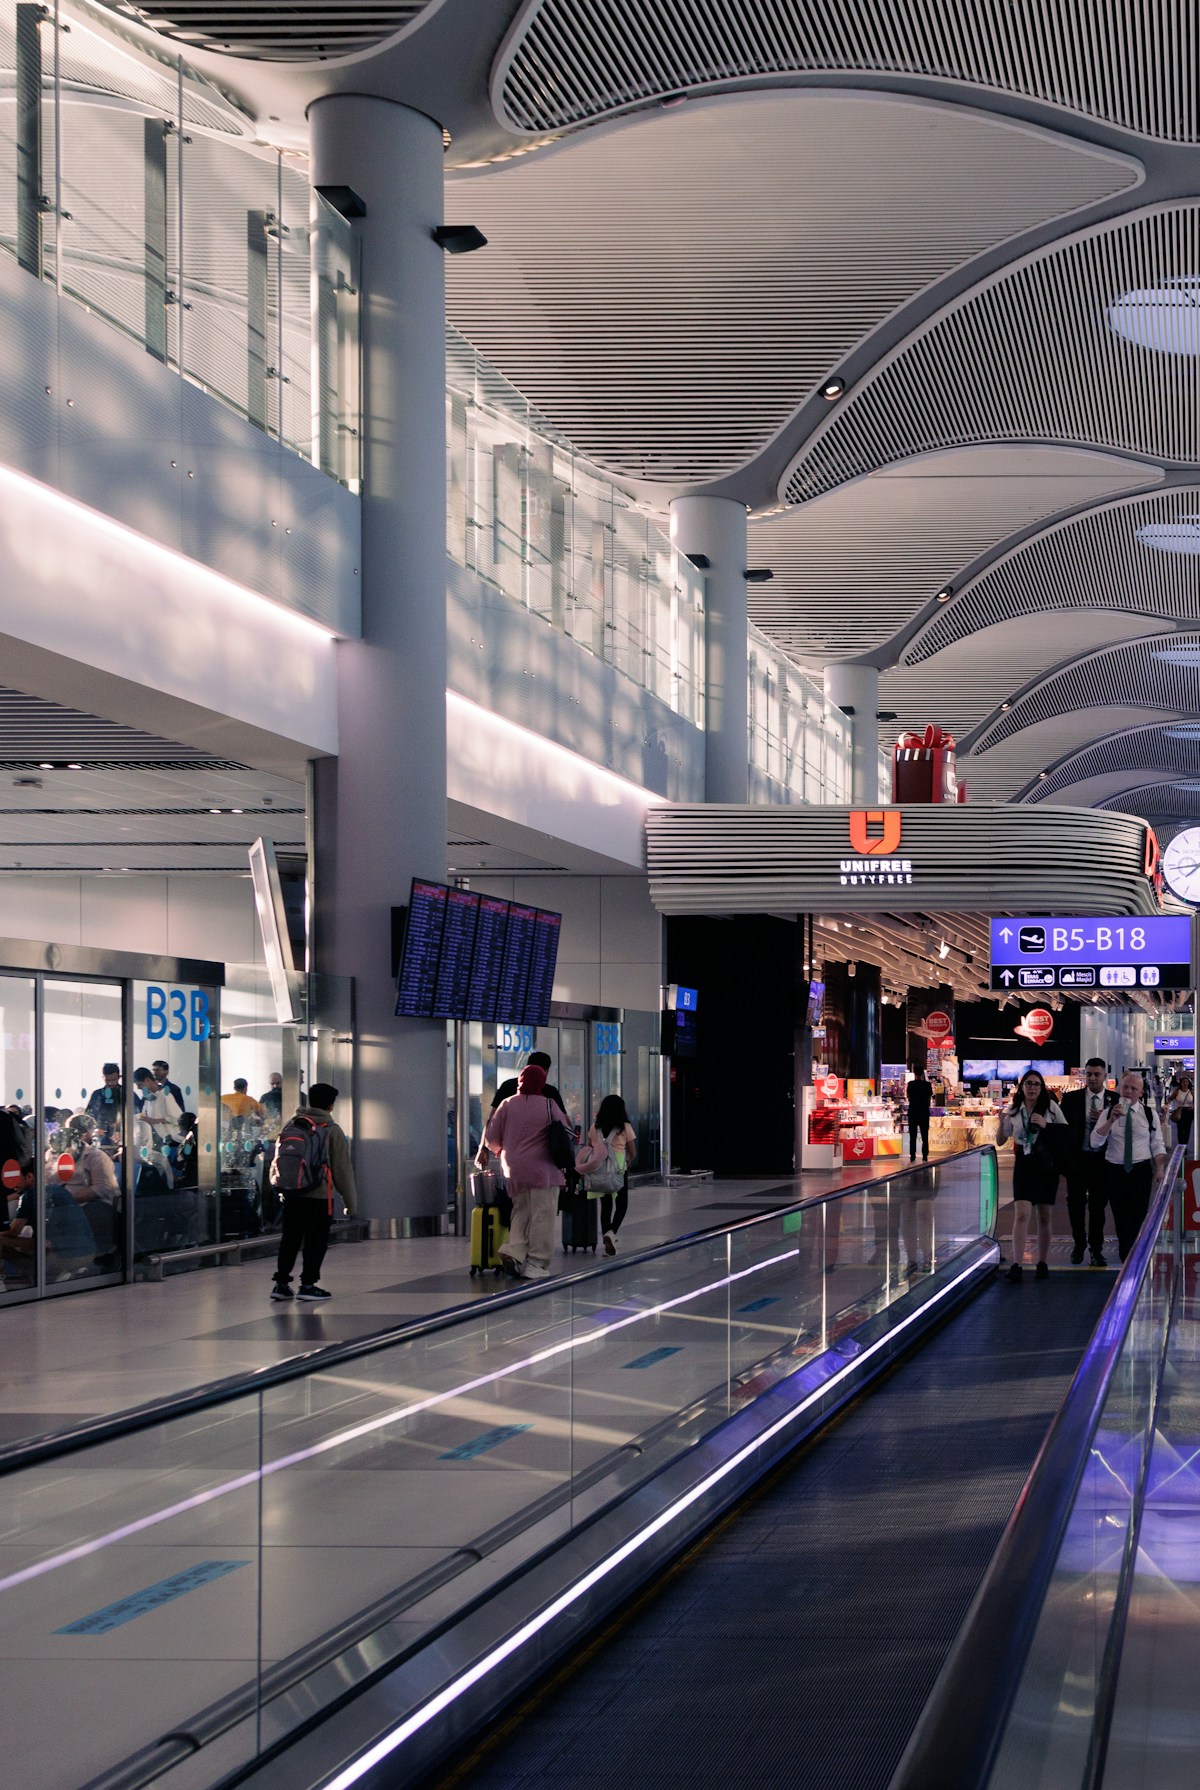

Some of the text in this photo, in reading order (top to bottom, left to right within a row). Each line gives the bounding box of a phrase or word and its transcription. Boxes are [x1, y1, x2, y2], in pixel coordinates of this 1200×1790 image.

[840, 860, 912, 872] UNIFREE
[1052, 927, 1146, 951] B5-B18
[683, 992, 691, 1006] B3
[147, 986, 210, 1042] B3B
[503, 1023, 533, 1052] B3B
[596, 1023, 619, 1055] B3B
